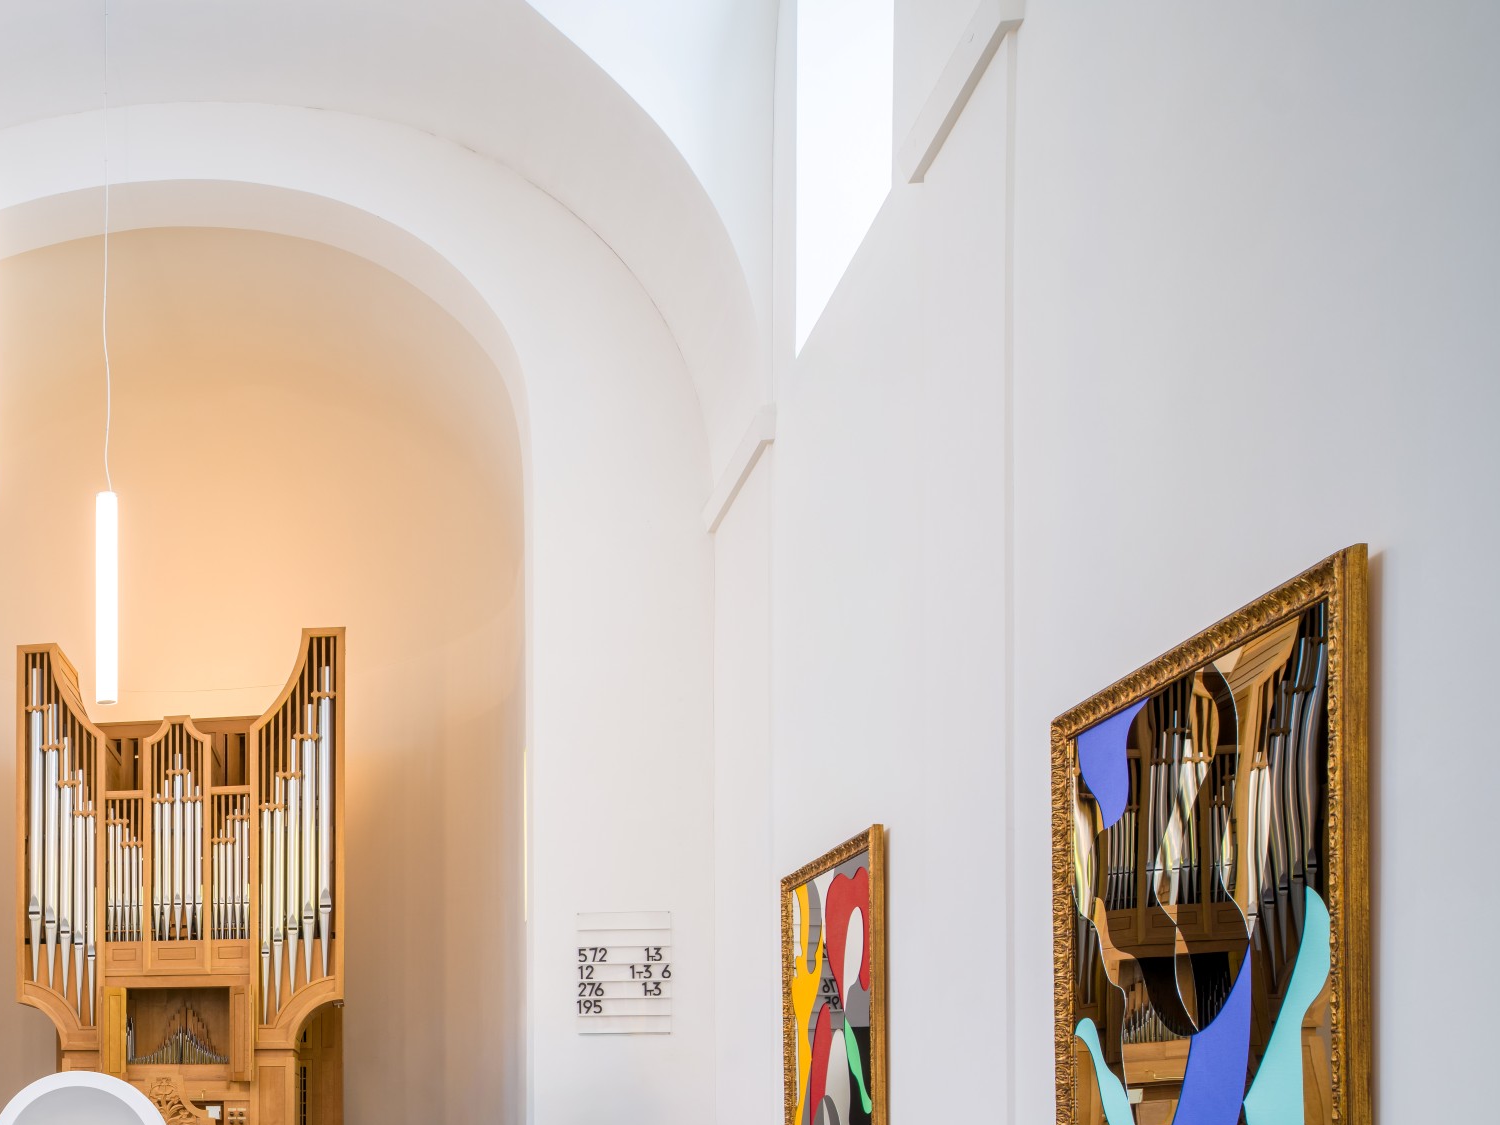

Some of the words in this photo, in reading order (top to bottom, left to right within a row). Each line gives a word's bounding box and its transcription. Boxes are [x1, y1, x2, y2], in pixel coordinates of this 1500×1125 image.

[578, 947, 607, 962] 572
[578, 965, 594, 979] 12
[661, 964, 671, 979] 6
[578, 982, 604, 997] 276
[576, 999, 603, 1014] 195
